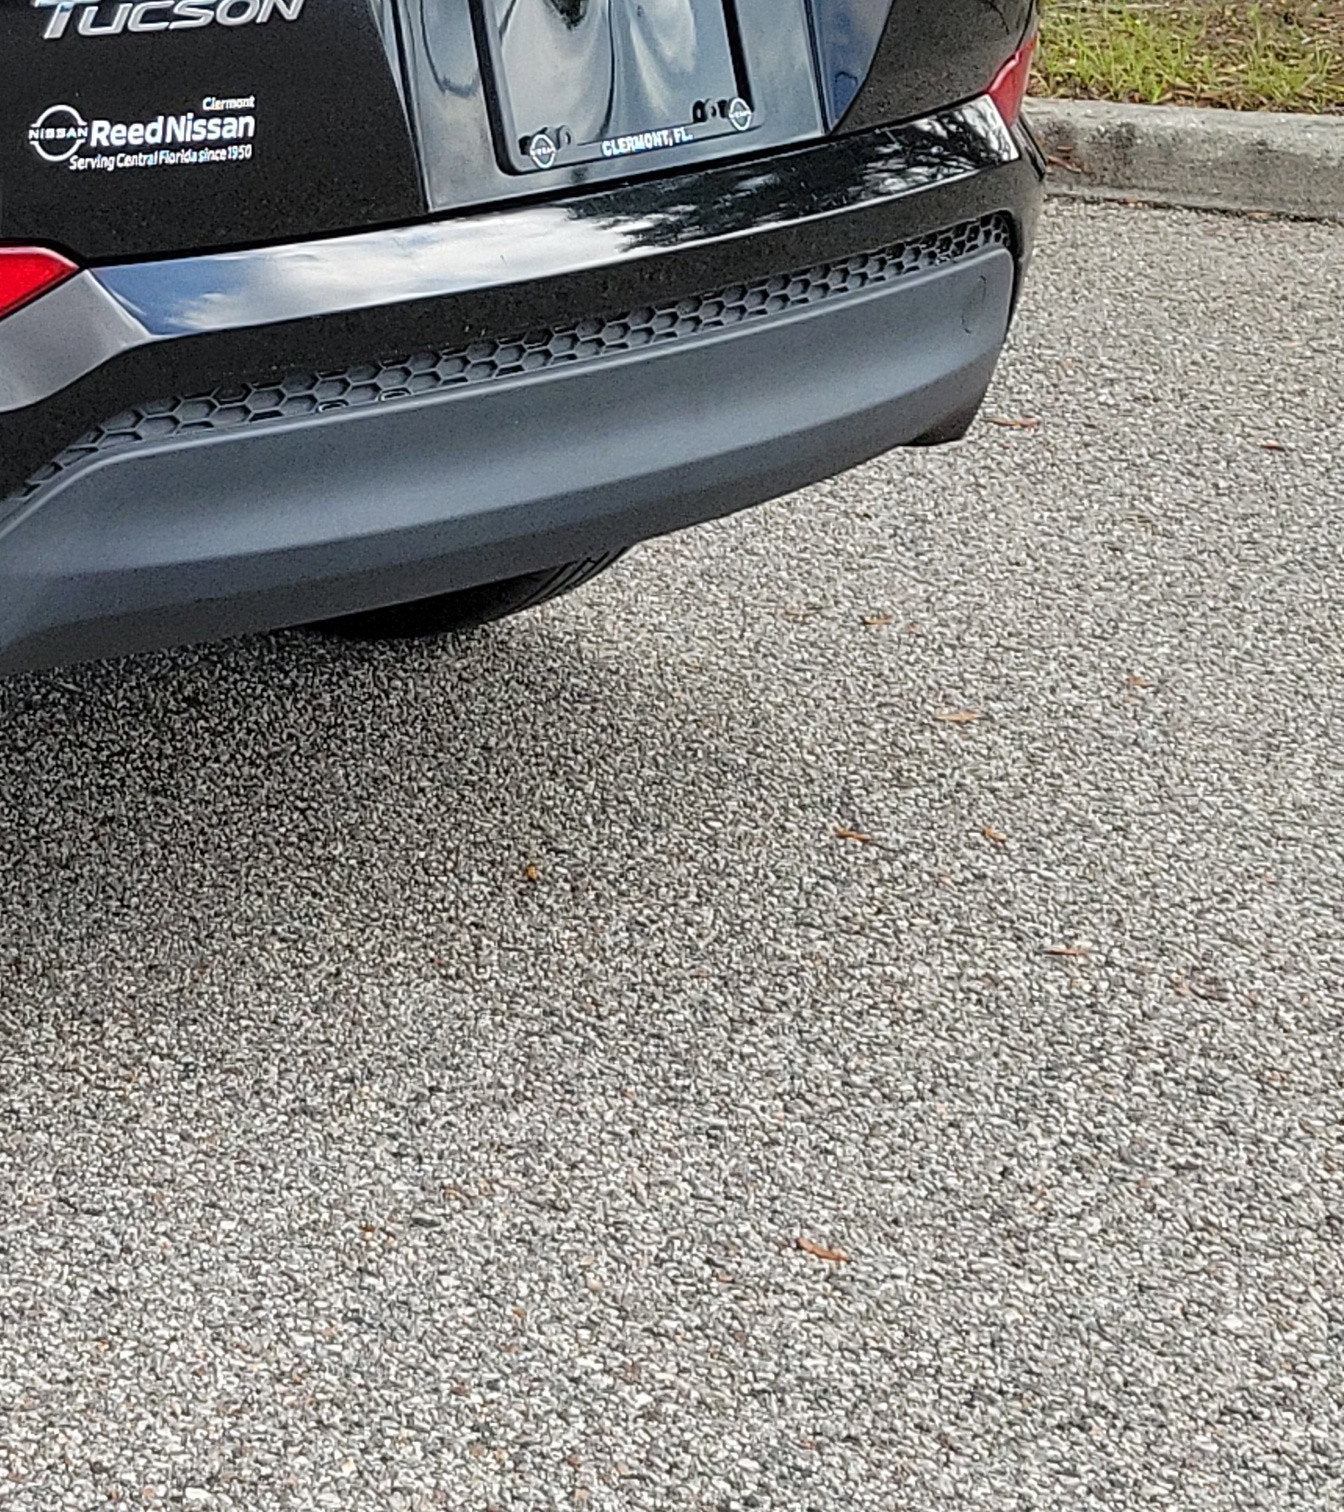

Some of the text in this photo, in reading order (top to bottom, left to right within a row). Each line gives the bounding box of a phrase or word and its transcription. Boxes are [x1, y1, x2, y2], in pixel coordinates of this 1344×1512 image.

[202, 94, 256, 111] Clermont
[27, 125, 89, 141] NISSAN
[674, 126, 694, 146] FL.
[69, 143, 253, 172] Serving Central Florida since 1950
